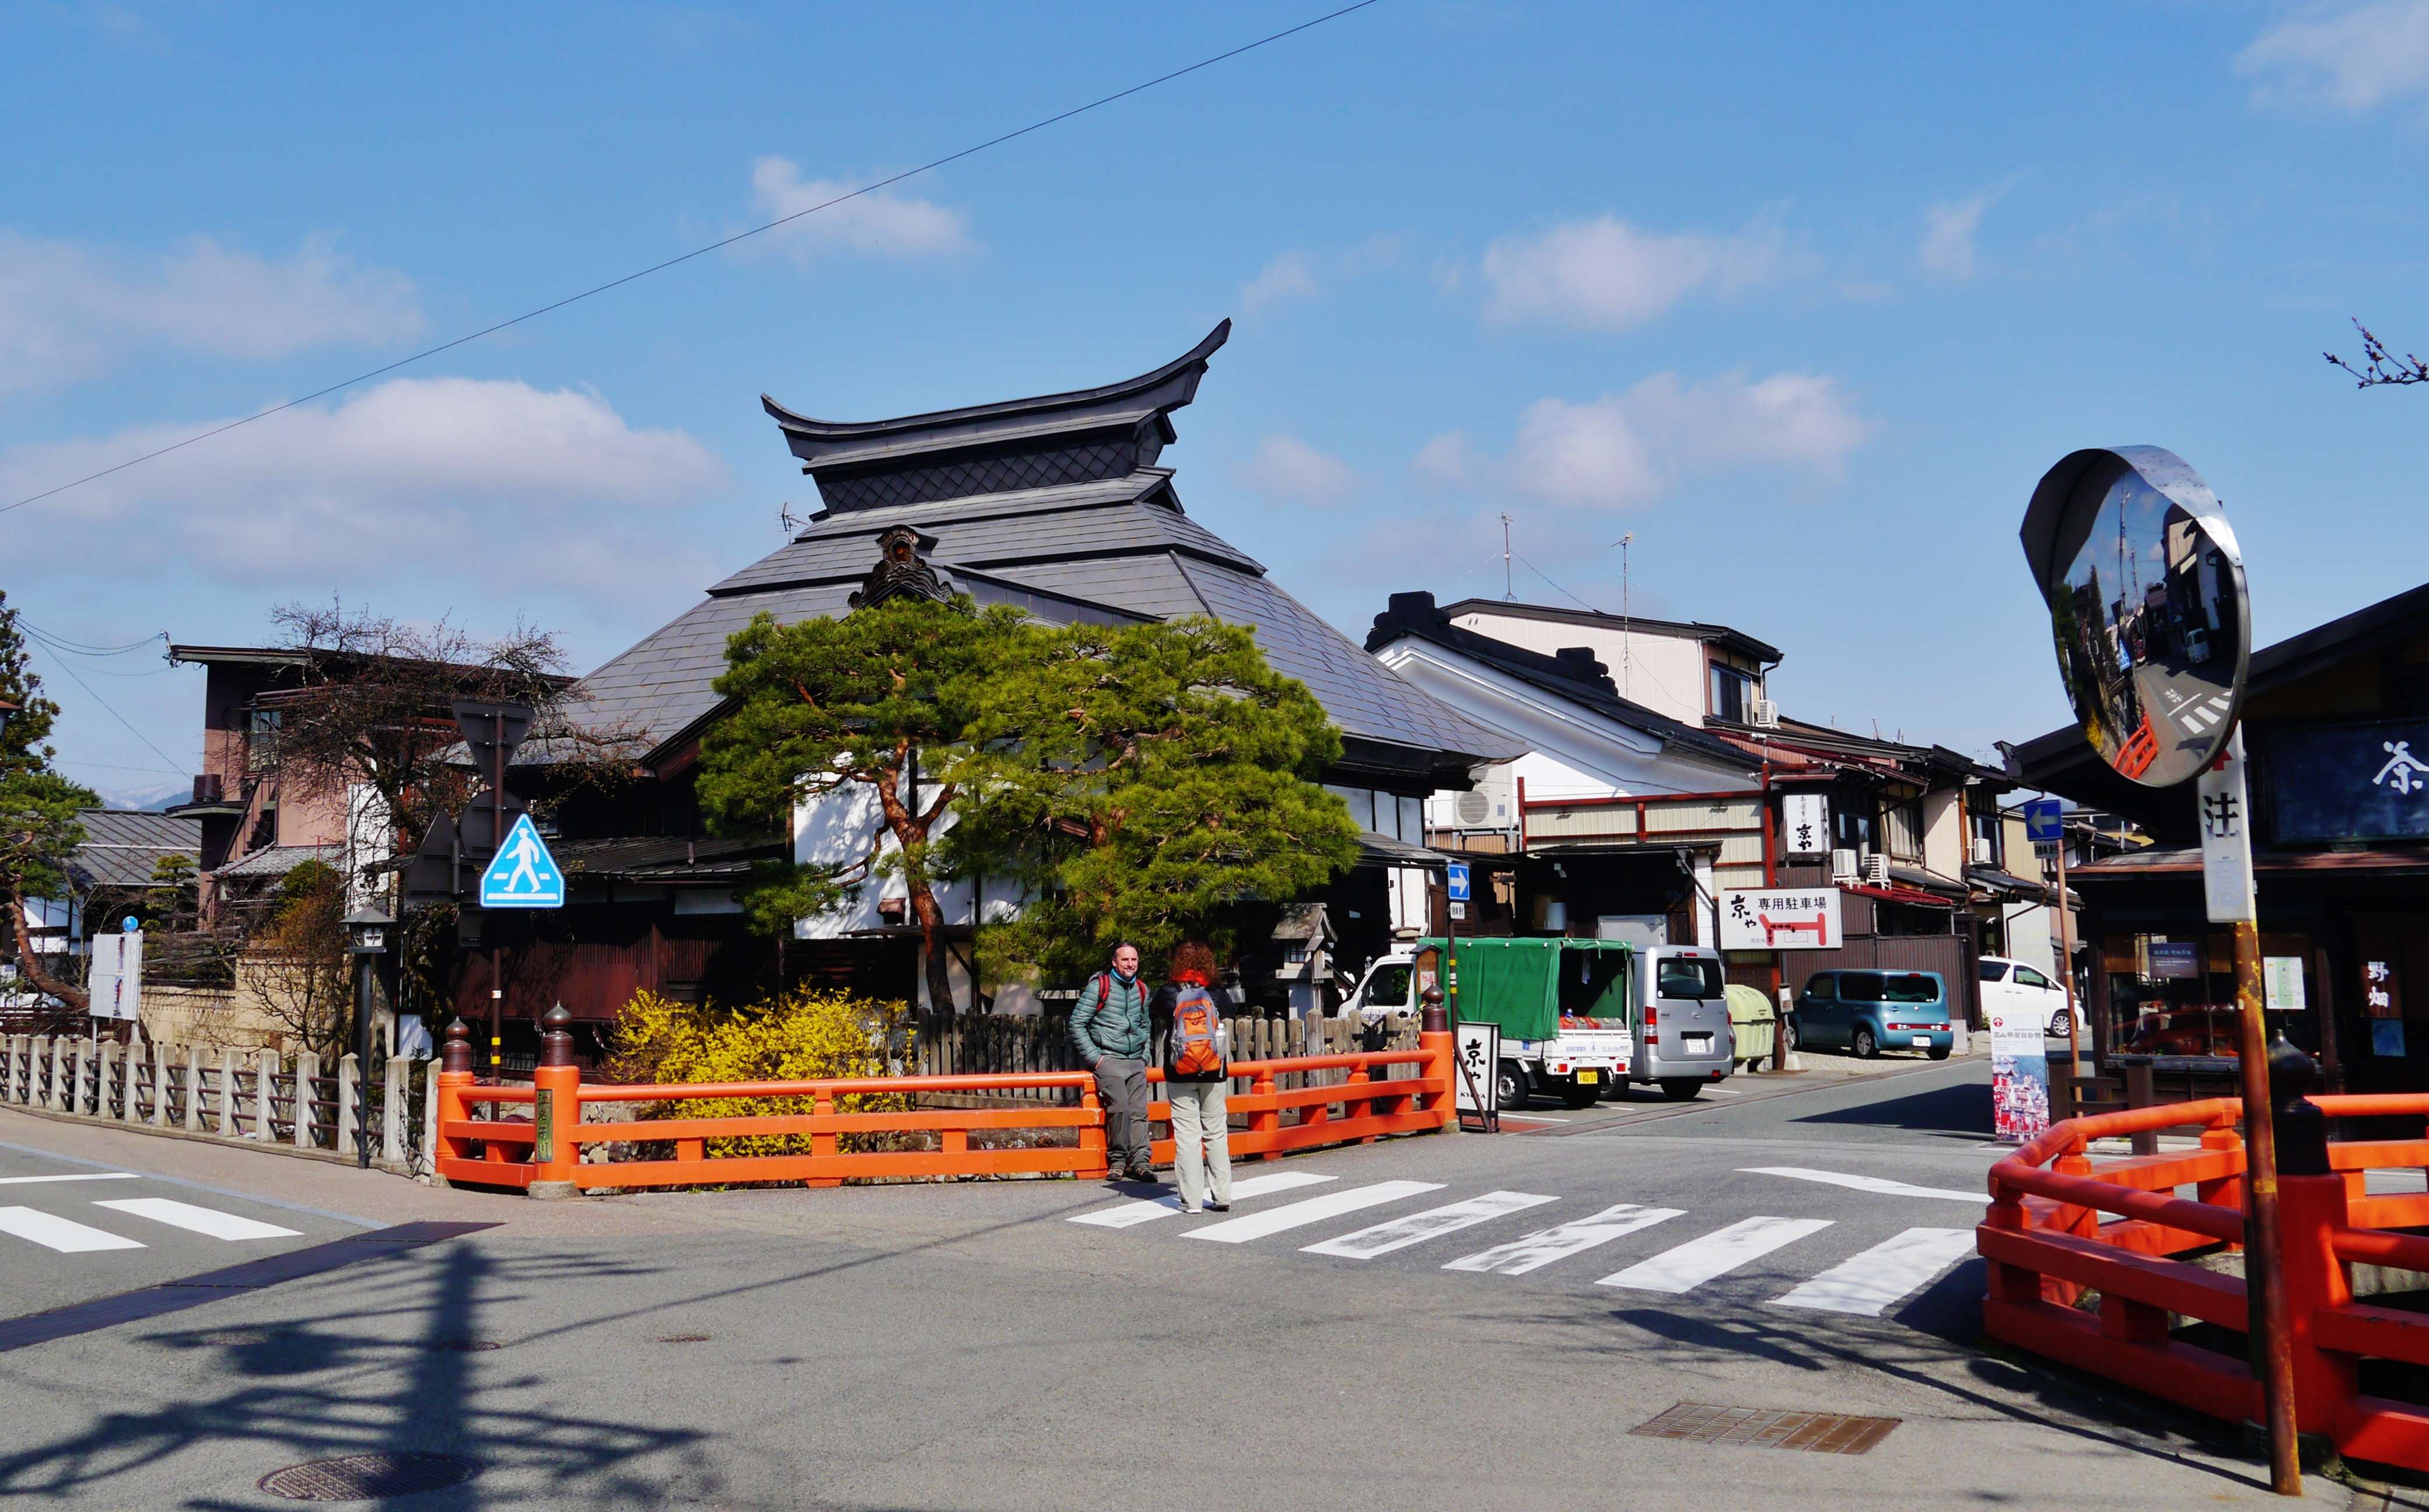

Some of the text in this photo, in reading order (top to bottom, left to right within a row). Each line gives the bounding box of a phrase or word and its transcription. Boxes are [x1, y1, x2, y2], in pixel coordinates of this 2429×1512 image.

[2372, 741, 2429, 794] 茶
[1796, 824, 1812, 850] 京や
[1730, 894, 1757, 929] 京や
[1758, 896, 1827, 911] 専用駐車場
[2367, 961, 2389, 1008] 野畑
